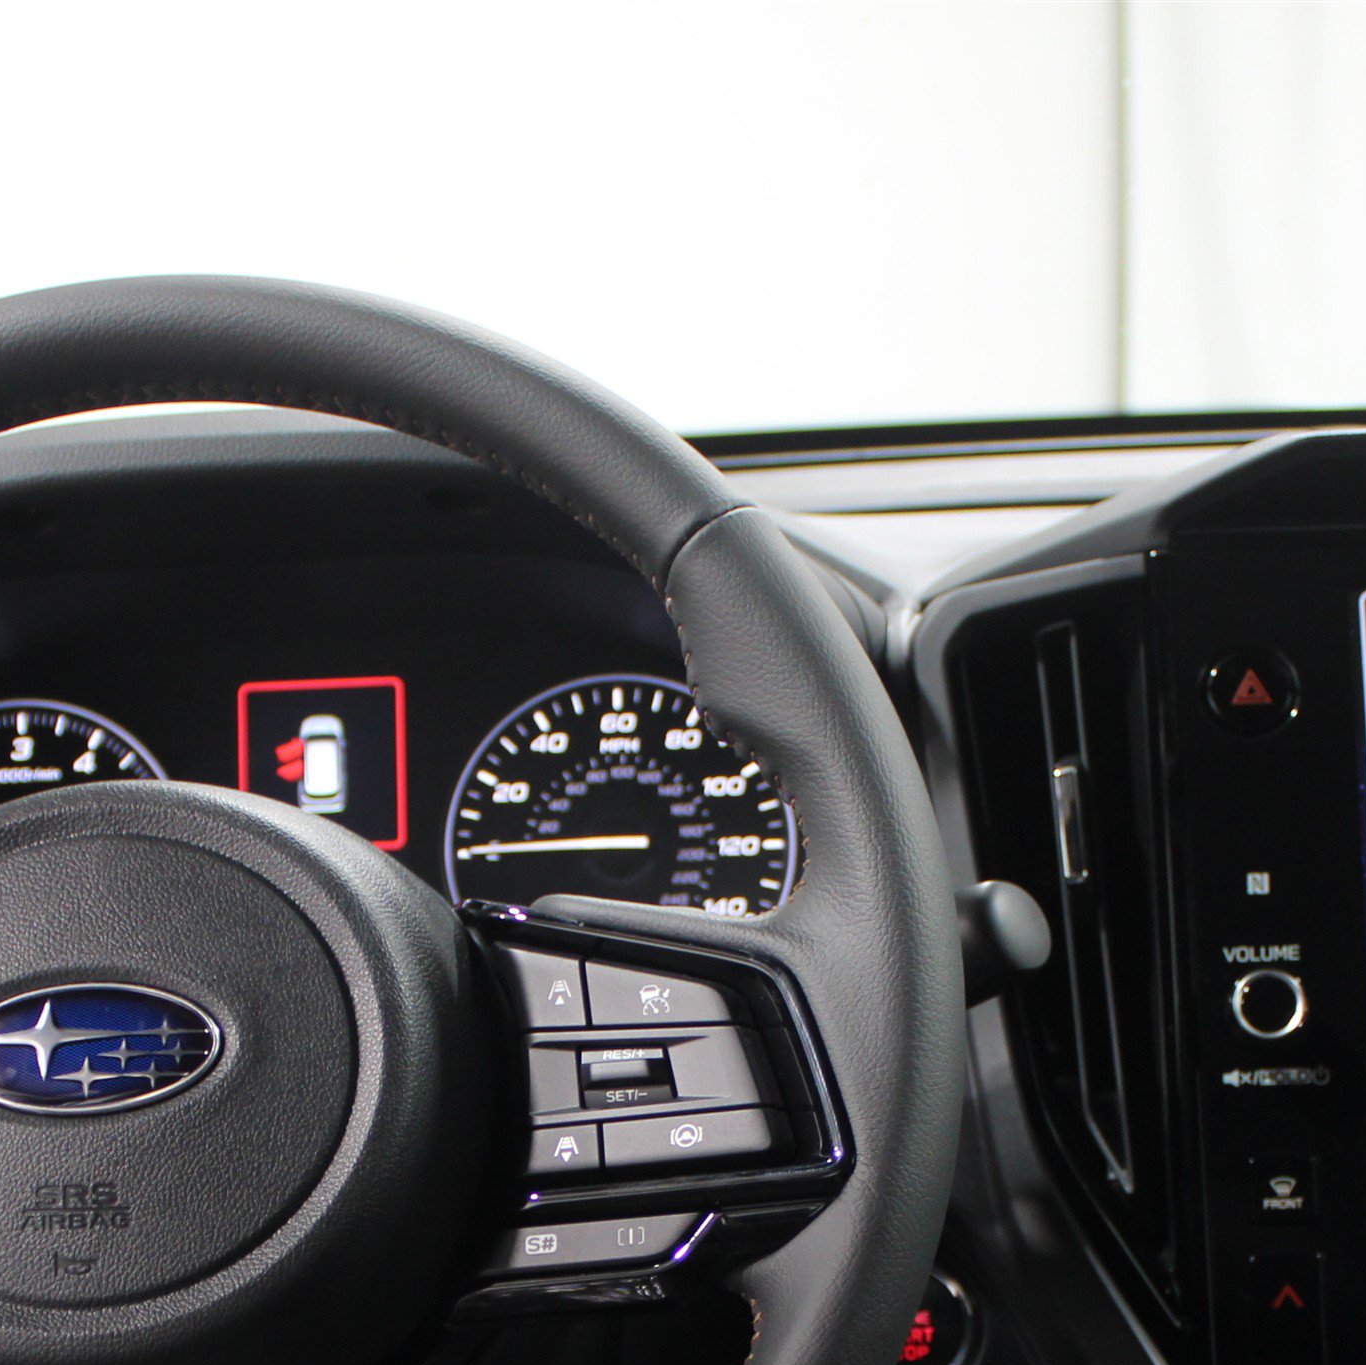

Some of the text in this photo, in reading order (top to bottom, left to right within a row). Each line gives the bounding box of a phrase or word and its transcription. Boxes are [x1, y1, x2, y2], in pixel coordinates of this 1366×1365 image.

[600, 712, 637, 733] 60
[10, 736, 34, 761] 3
[530, 732, 569, 753] 40
[599, 737, 641, 754] MPH
[665, 728, 702, 749] 80
[73, 751, 97, 774] 4
[492, 782, 529, 803] 20
[702, 776, 746, 797] 100
[718, 836, 761, 856] 120
[702, 896, 747, 916] 140
[1222, 944, 1300, 963] VOLUME
[35, 1182, 118, 1208] SRS
[1262, 1197, 1304, 1210] FRONT
[20, 1211, 132, 1231] AIRBAG
